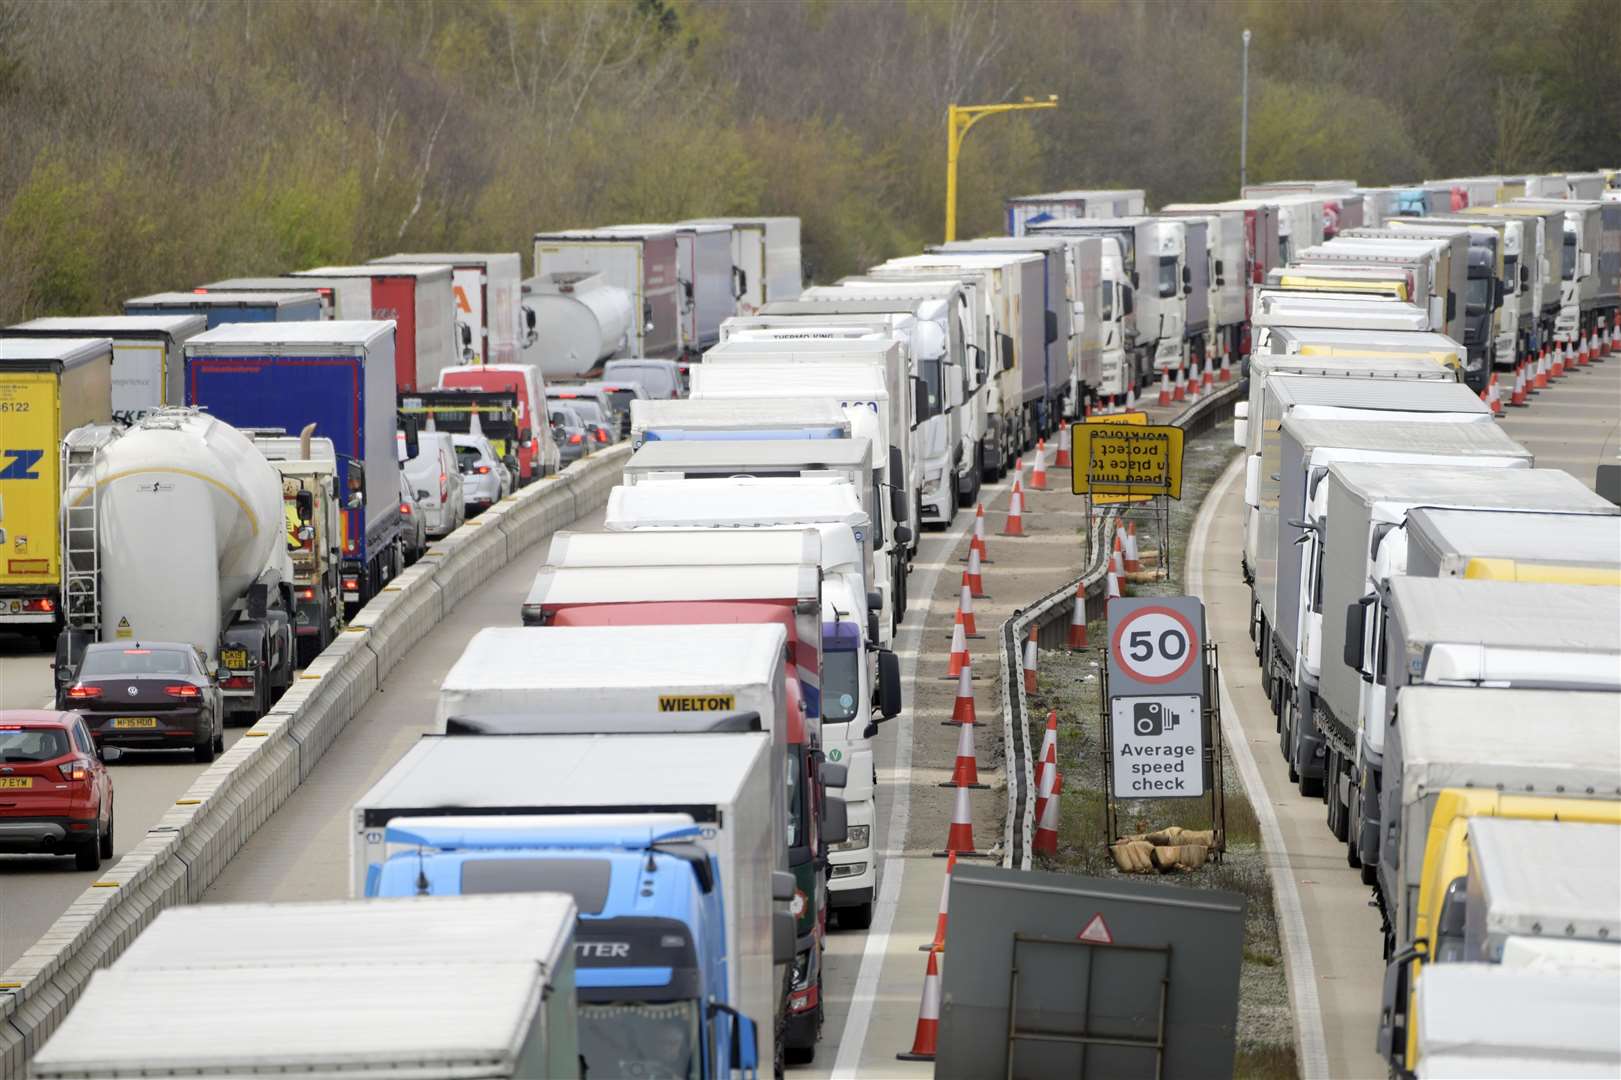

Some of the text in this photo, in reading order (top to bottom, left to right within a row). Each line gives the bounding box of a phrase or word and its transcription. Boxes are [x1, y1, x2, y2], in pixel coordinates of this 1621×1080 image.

[0, 402, 30, 413] 6122
[1090, 430, 1168, 442] workforce
[1101, 445, 1158, 457] protect
[1110, 461, 1151, 472] place
[1130, 629, 1186, 662] 50
[659, 698, 731, 712] WIELTON
[1120, 743, 1195, 758] Average
[1131, 760, 1185, 774] speed
[1132, 777, 1185, 791] check
